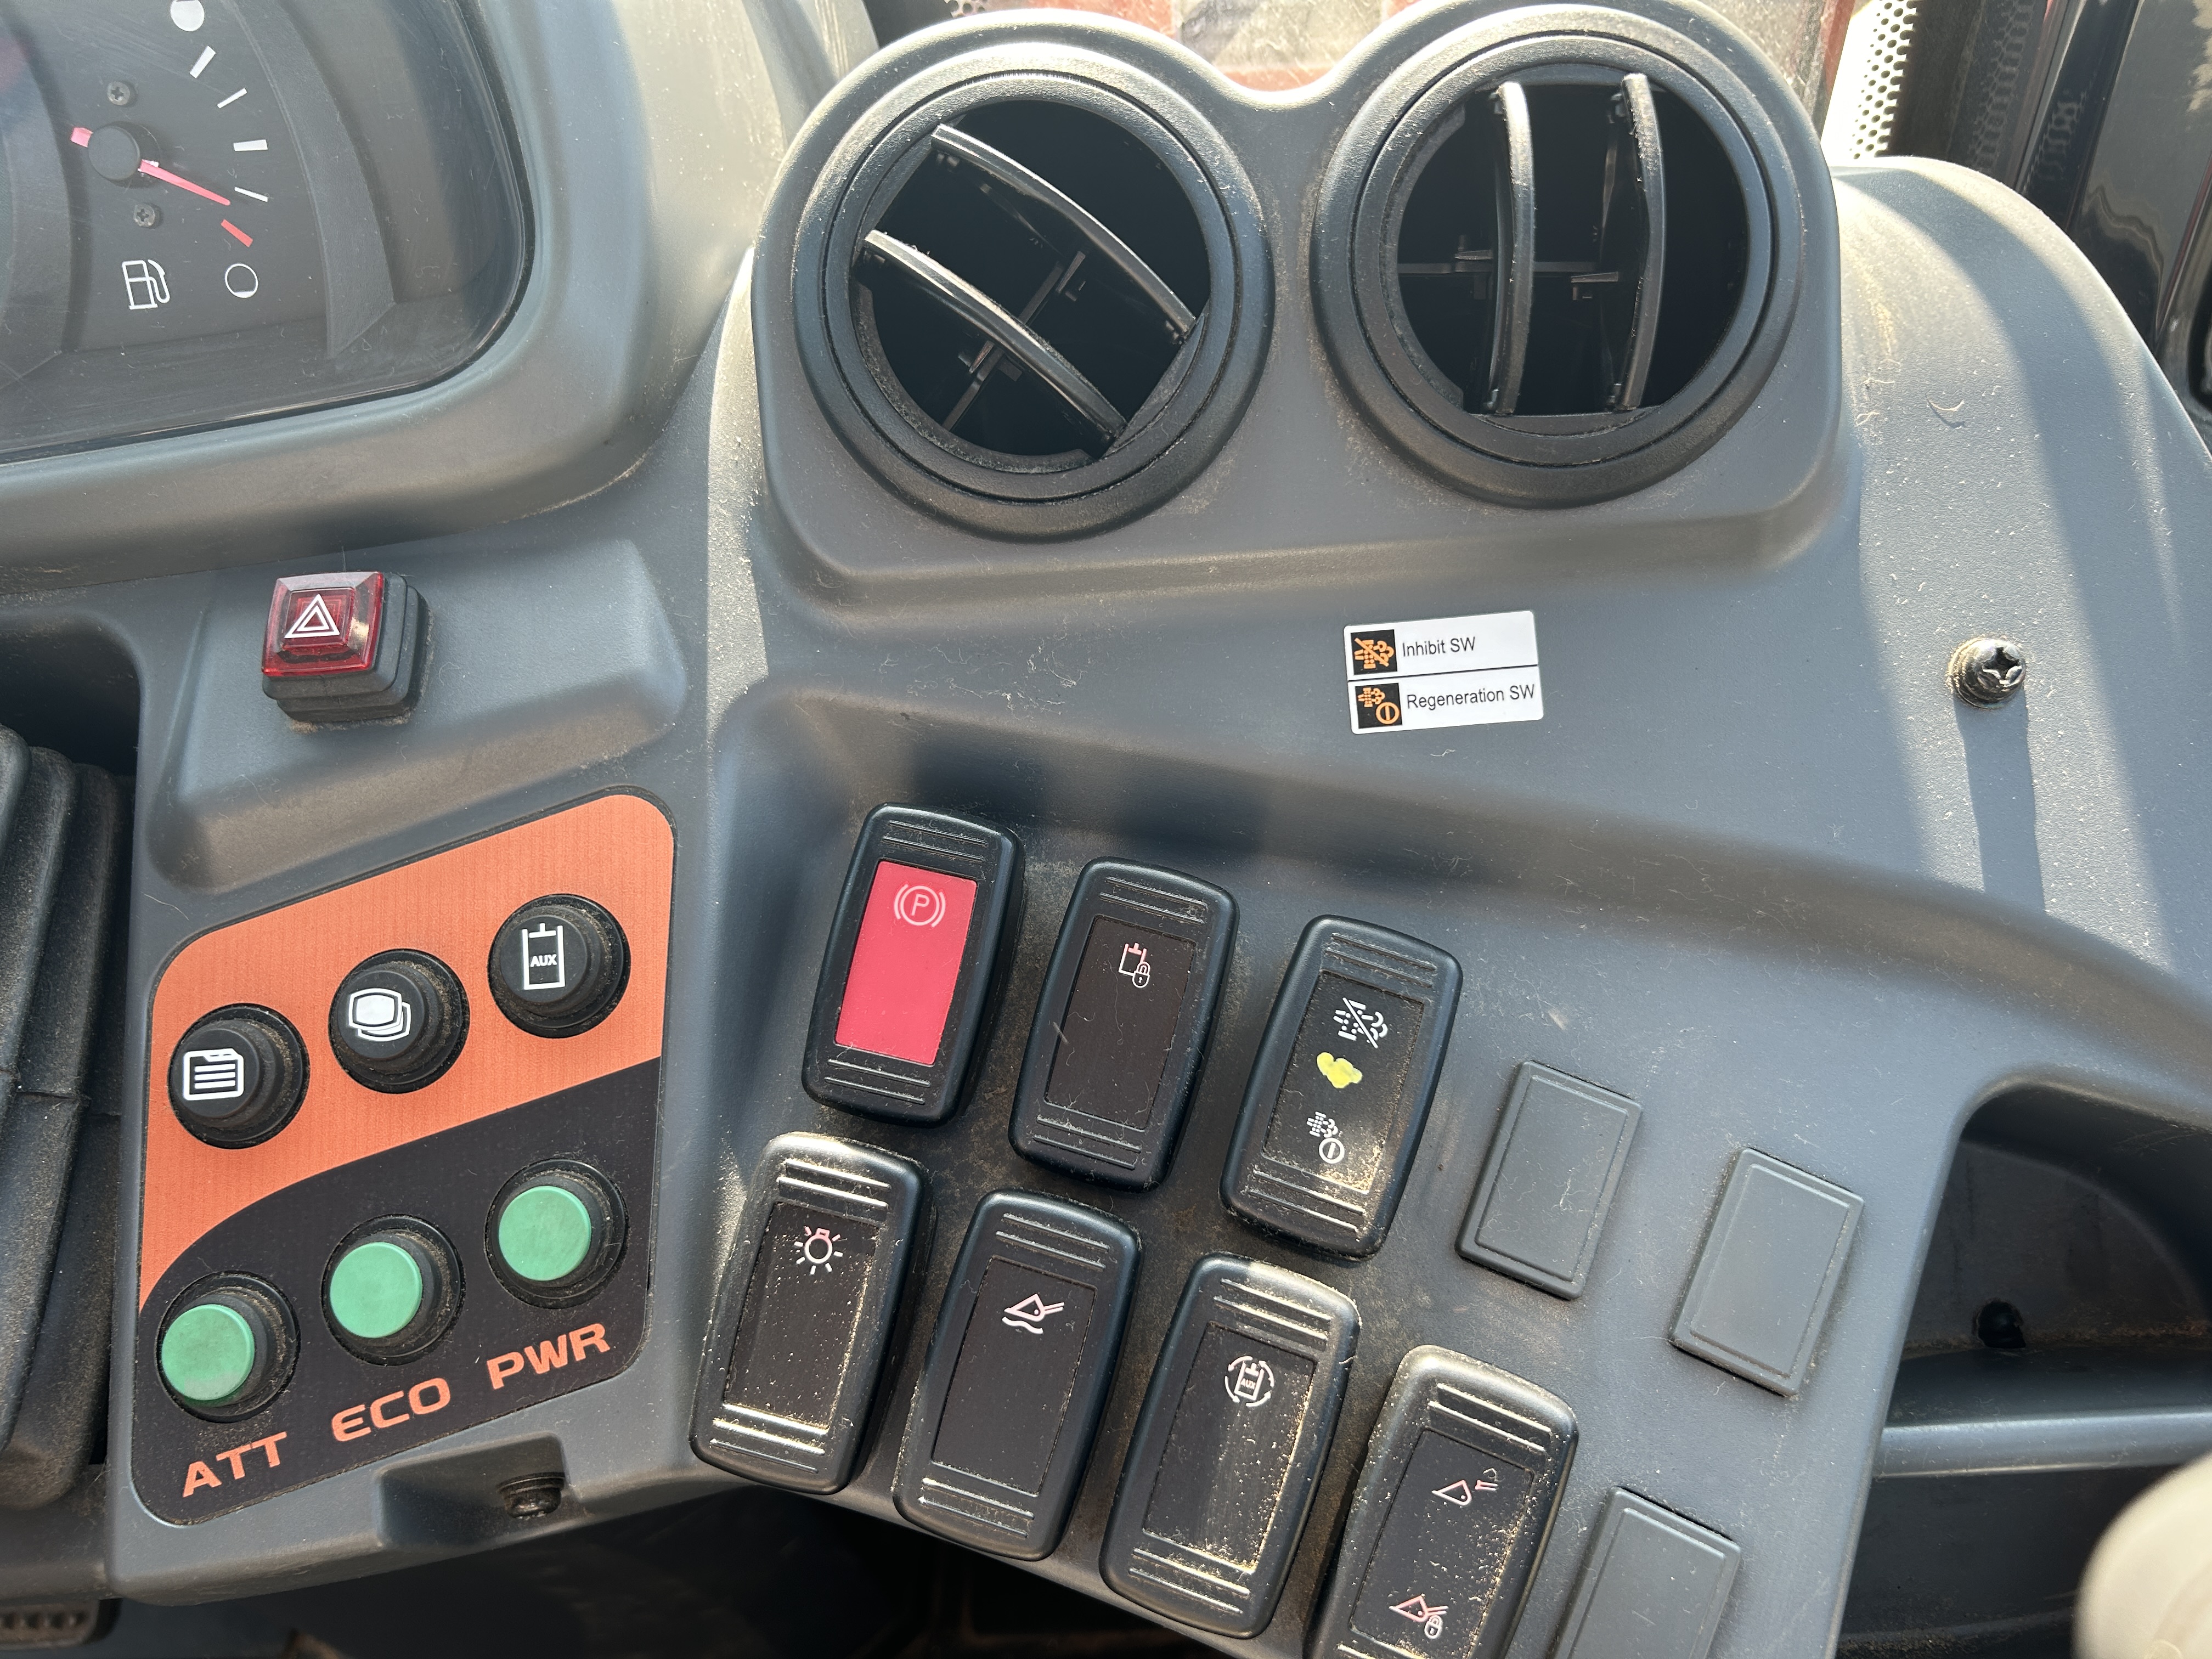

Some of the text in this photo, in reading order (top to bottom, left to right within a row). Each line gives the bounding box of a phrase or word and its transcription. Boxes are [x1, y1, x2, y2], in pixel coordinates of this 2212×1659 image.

[1402, 636, 1476, 657] Inhibit SW
[1407, 684, 1534, 710] Regeneration SW
[911, 893, 930, 916] P
[530, 953, 557, 967] AUX
[182, 1323, 611, 1498] ATT ECO PWR
